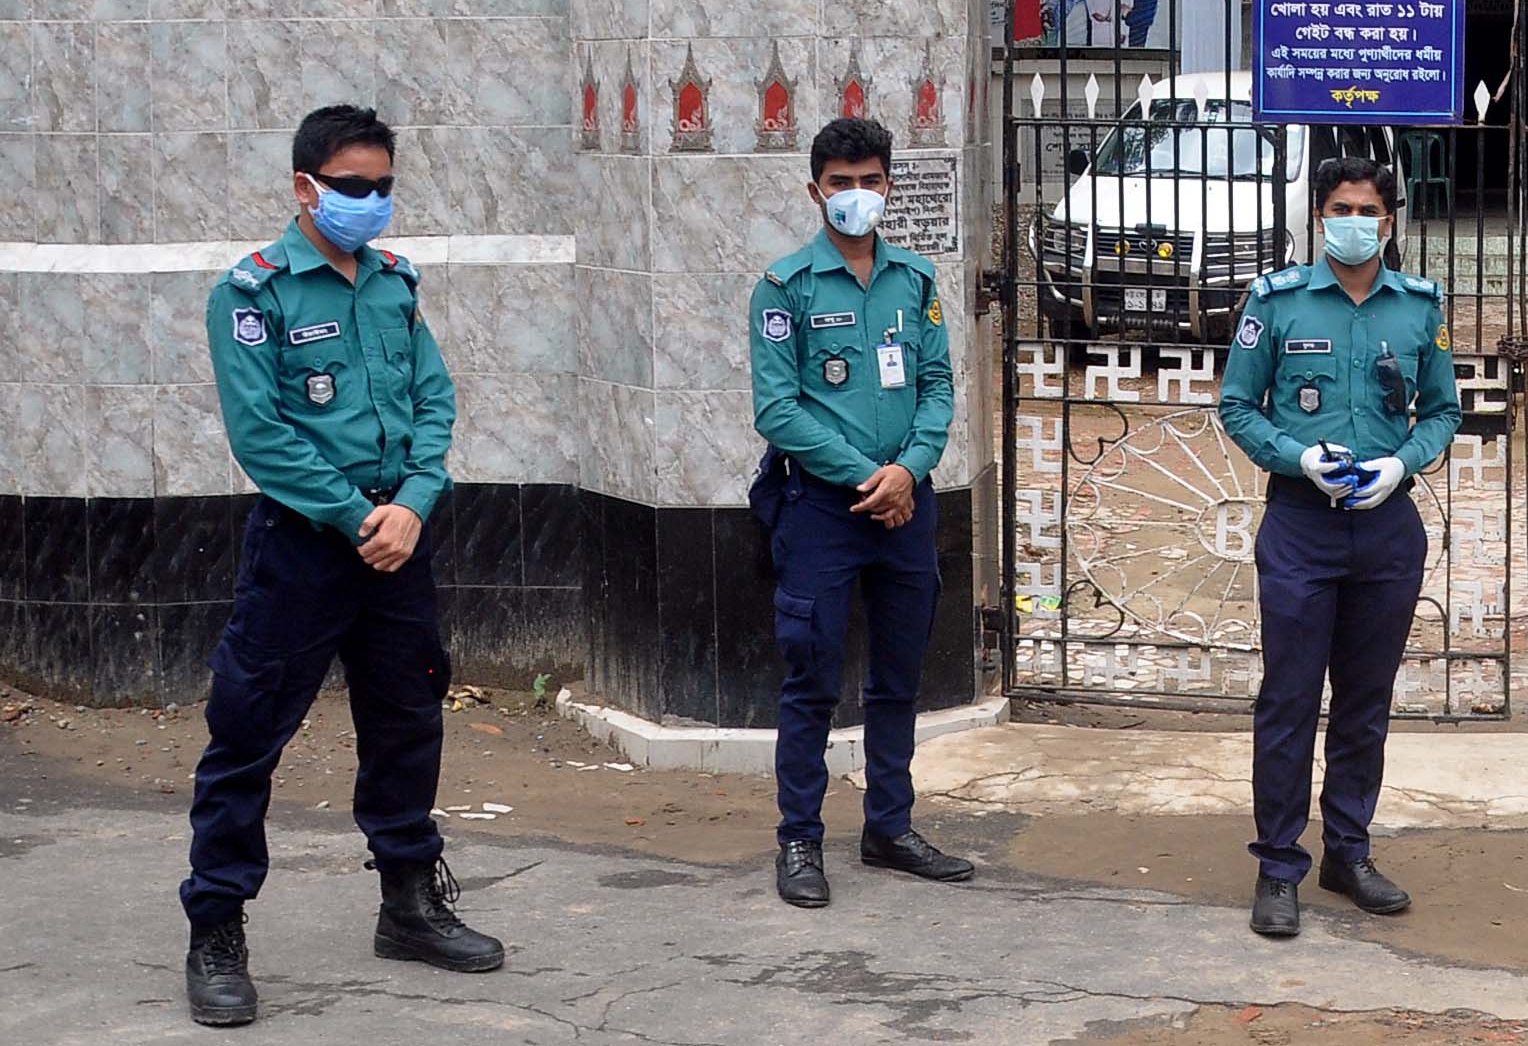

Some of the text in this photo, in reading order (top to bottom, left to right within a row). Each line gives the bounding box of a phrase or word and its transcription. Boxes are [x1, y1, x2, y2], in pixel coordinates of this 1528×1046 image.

[1271, 1, 1444, 18] খোলা হয় এবং রাত ১১ টায়
[1295, 23, 1329, 41] গেইট
[1333, 26, 1354, 40] বন্ধ
[1359, 27, 1384, 41] করা
[1271, 45, 1289, 60] এই
[1292, 48, 1327, 60] সময়ের
[1330, 48, 1355, 60] মধ্যে
[1415, 46, 1442, 62] ধর্মীয়
[1327, 67, 1349, 80] করার
[1352, 68, 1371, 80] জন্য
[1374, 68, 1409, 83] অনুরোধ
[1330, 86, 1381, 108] কর্তৃপক্ষ
[1215, 504, 1252, 557] B
